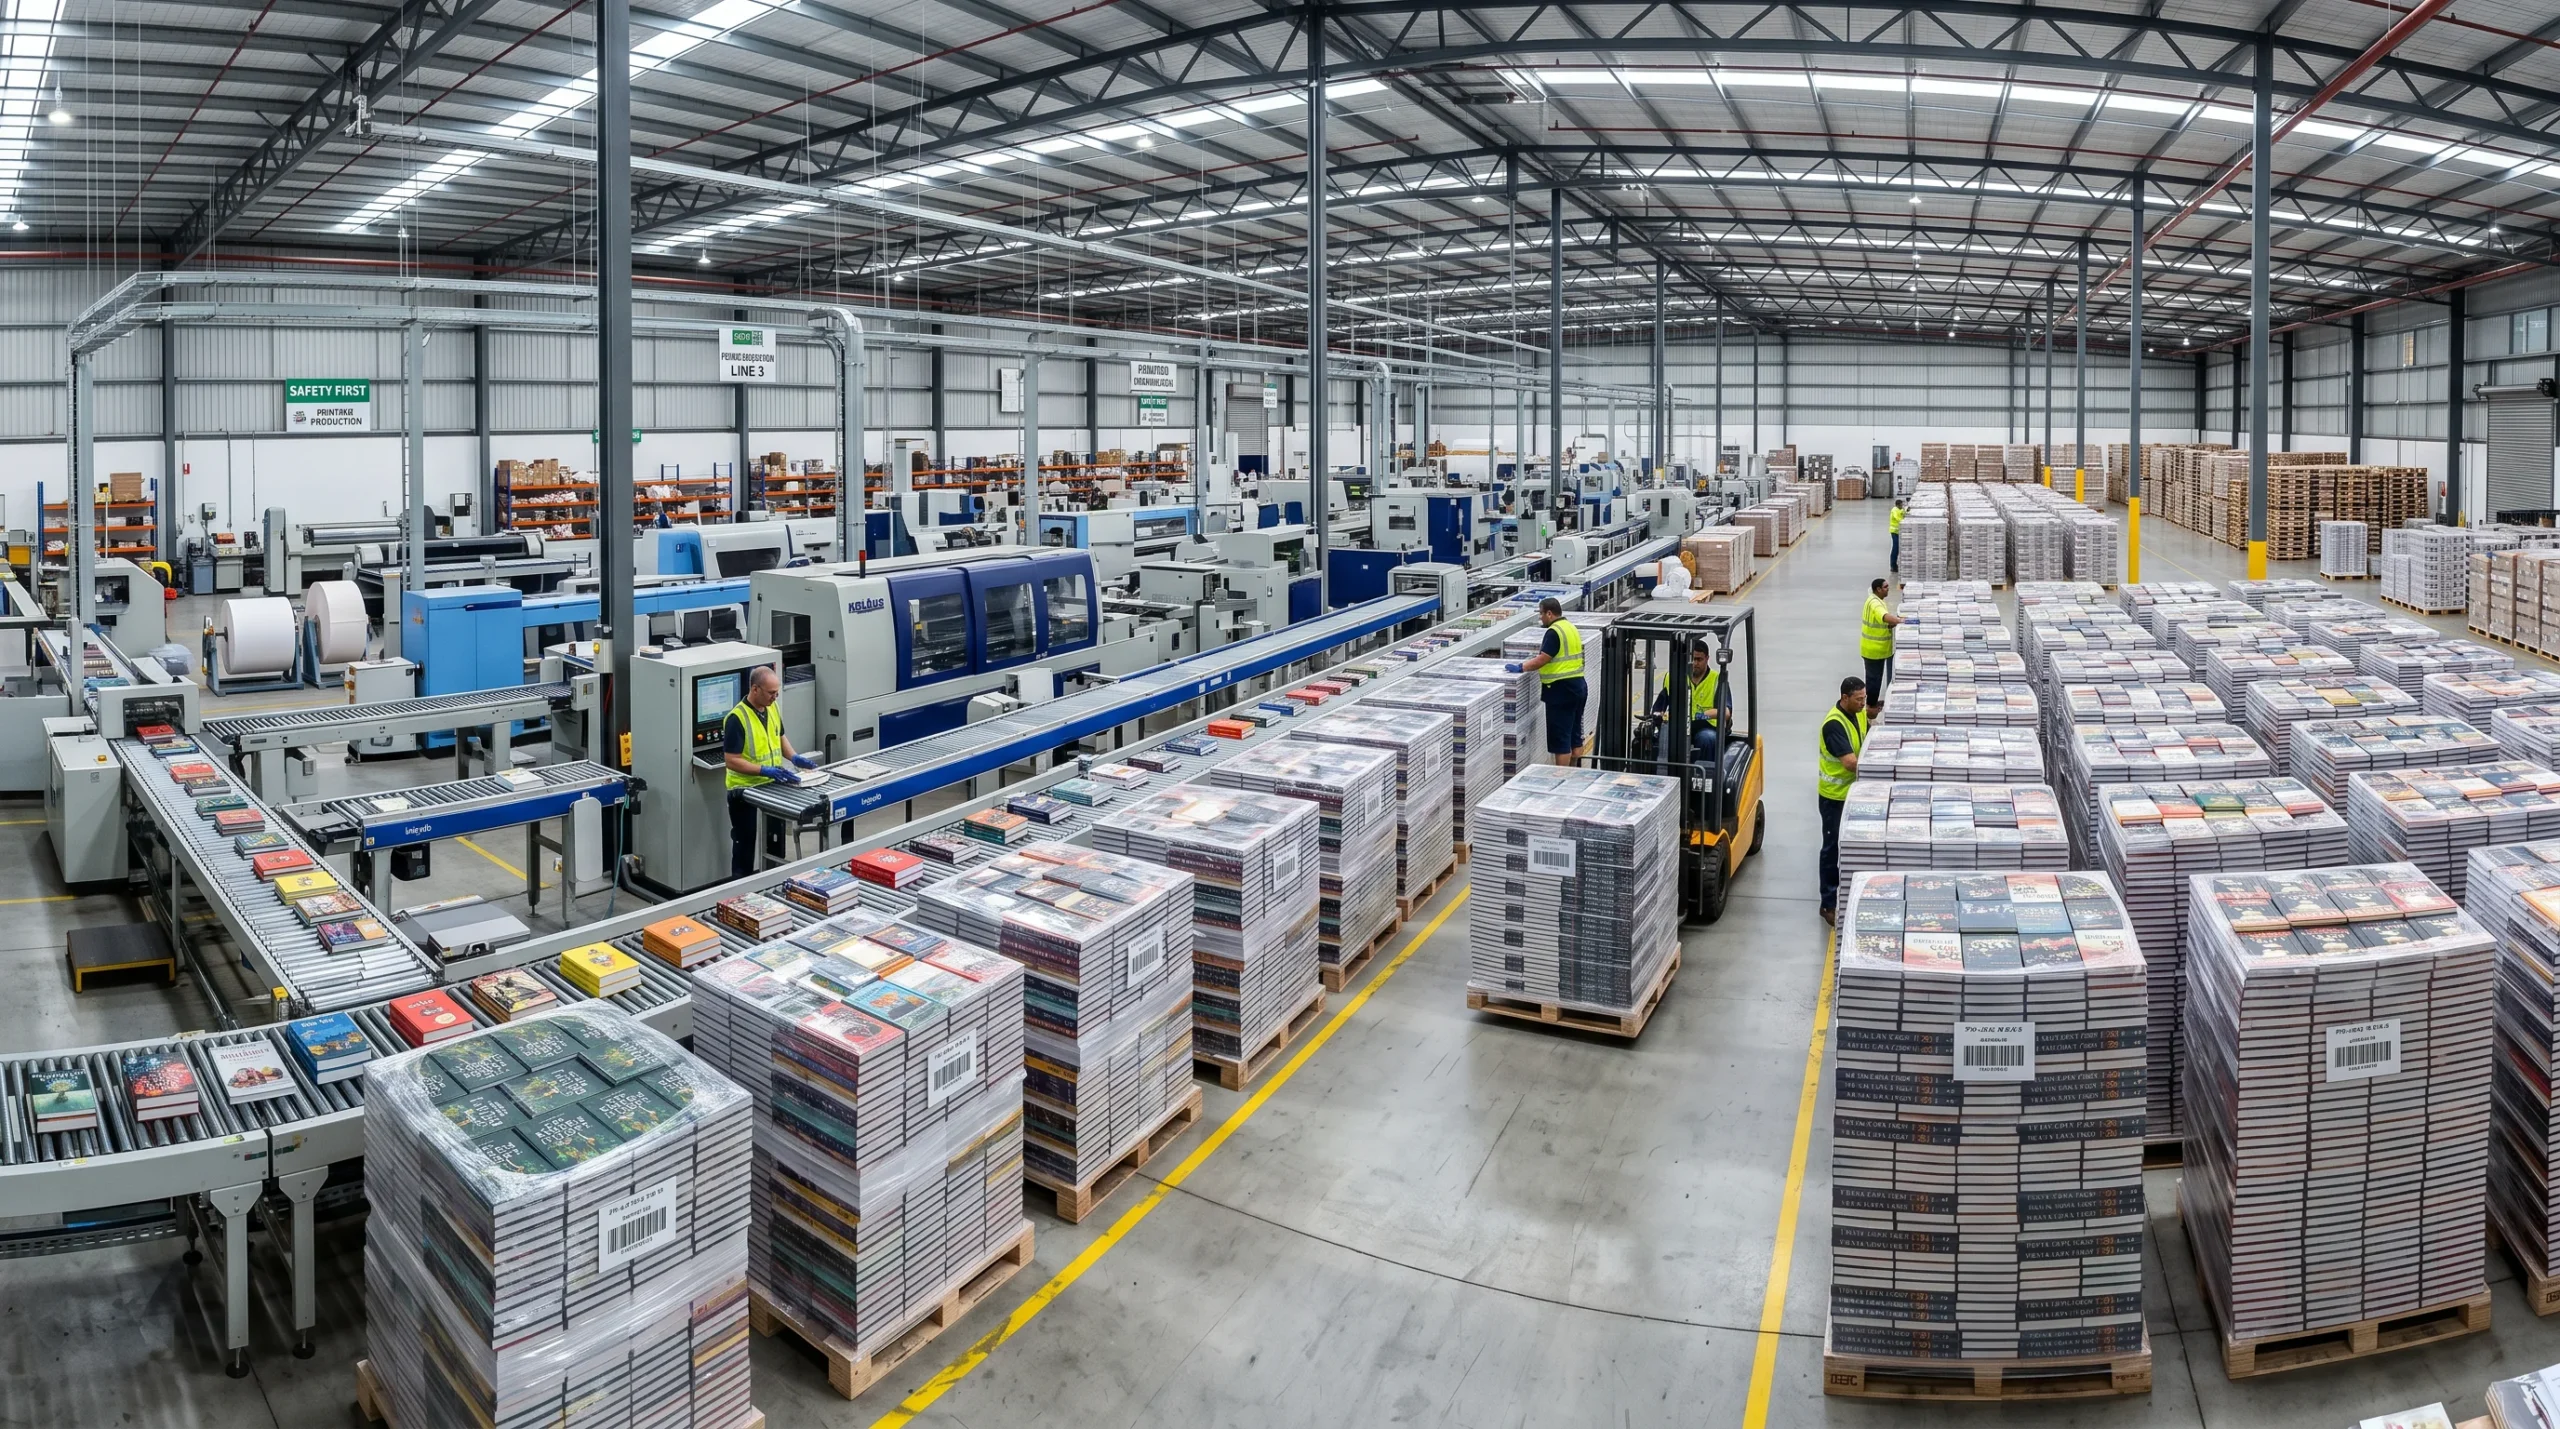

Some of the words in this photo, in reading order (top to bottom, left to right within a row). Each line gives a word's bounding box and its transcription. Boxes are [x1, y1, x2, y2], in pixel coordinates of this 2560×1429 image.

[731, 365, 756, 376] LINE
[758, 366, 765, 377] 3
[289, 385, 332, 396] SAFETY
[335, 385, 366, 396] FIRST
[310, 417, 362, 426] PRODUCTION
